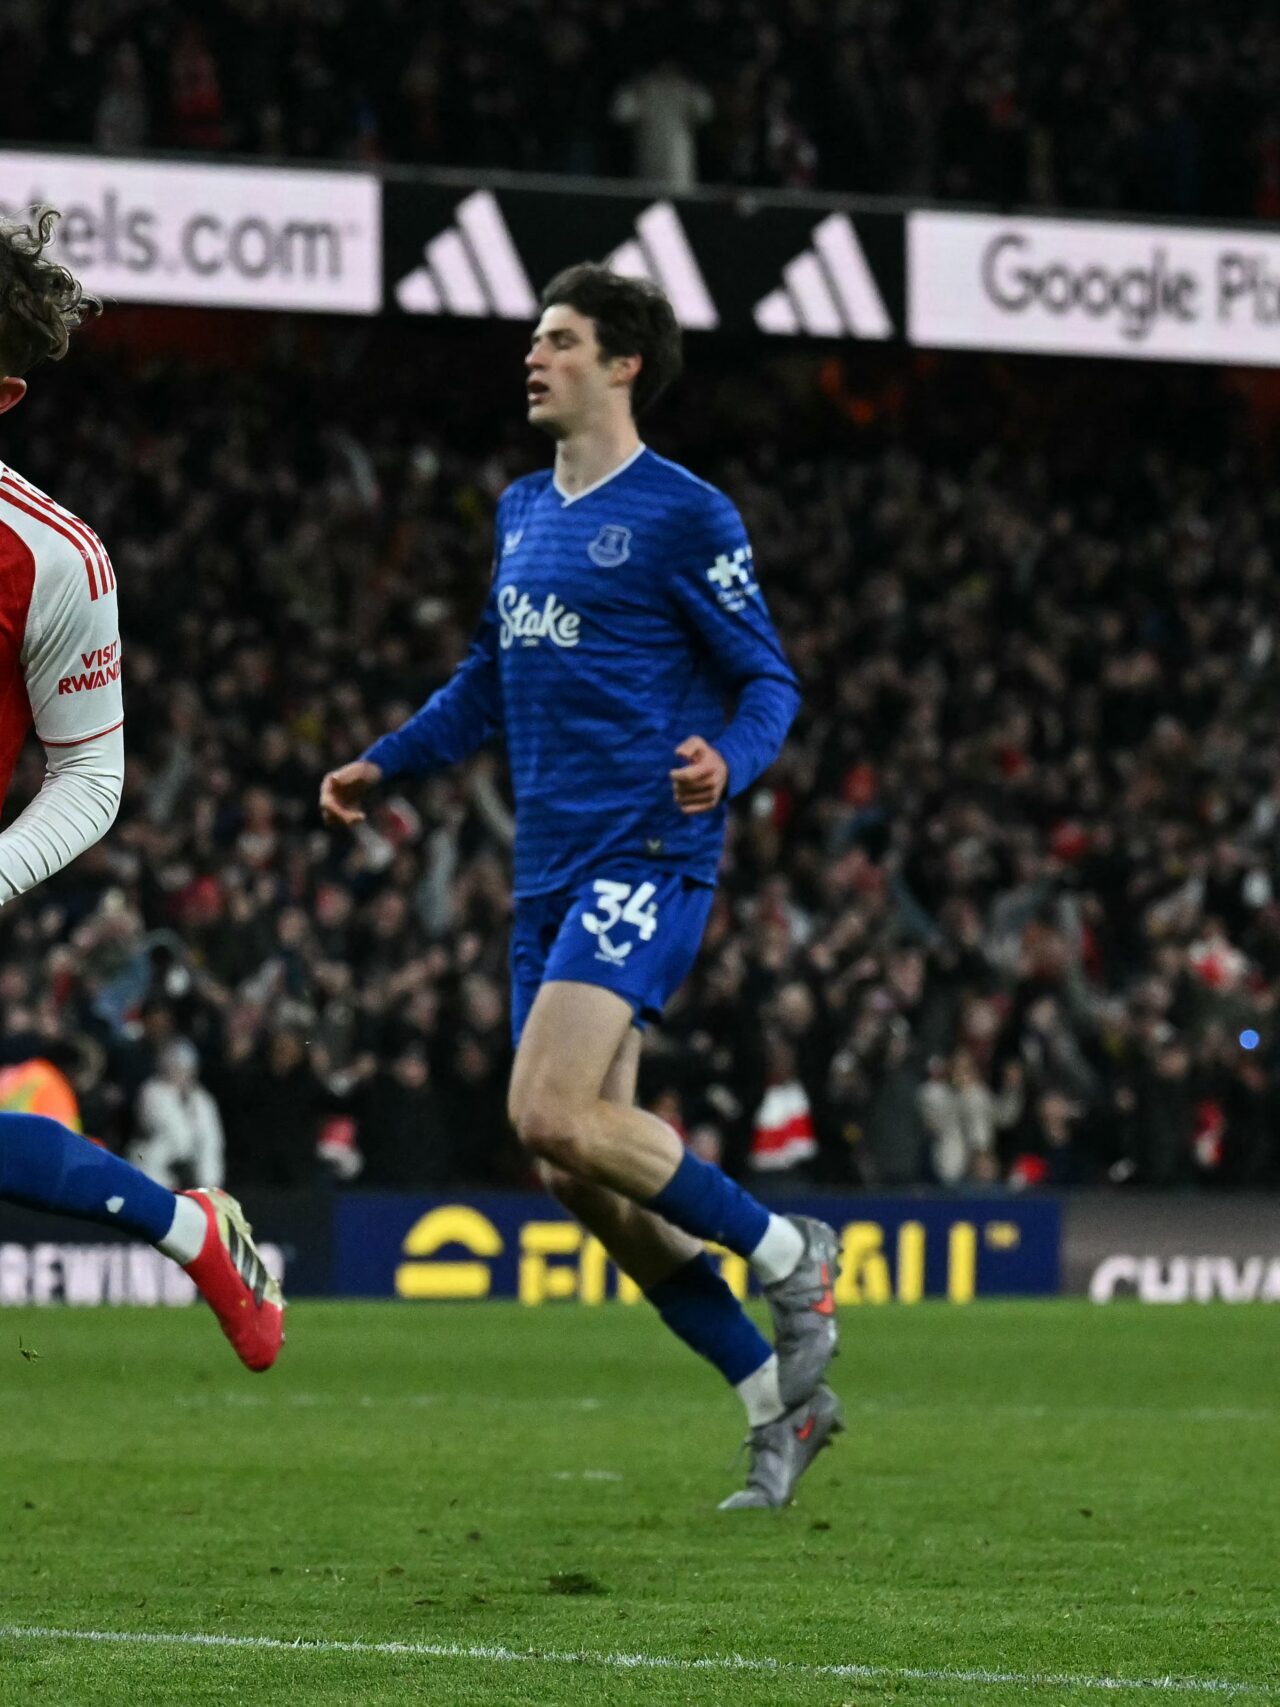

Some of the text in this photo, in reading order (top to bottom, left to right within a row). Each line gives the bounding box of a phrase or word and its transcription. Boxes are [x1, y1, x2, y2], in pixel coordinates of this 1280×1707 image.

[982, 234, 1197, 342] Google
[498, 585, 581, 650] Stake
[81, 640, 117, 670] VISIT
[582, 879, 657, 941] 34
[520, 1221, 977, 1305] FALL
